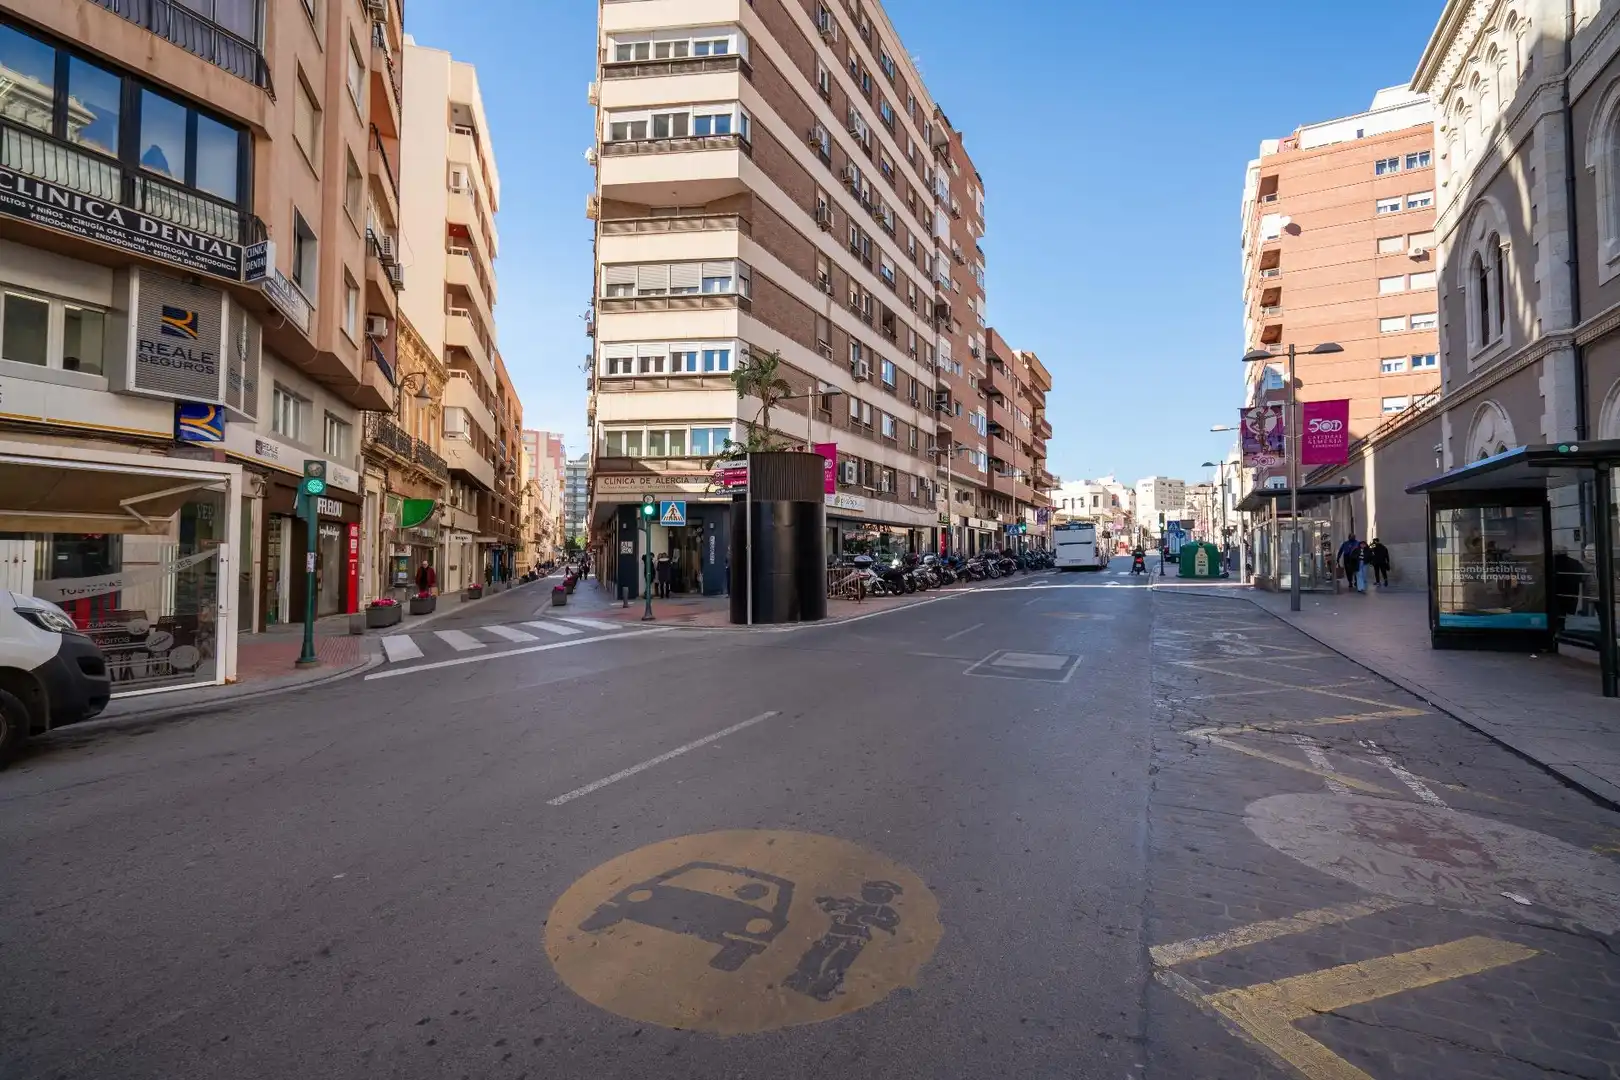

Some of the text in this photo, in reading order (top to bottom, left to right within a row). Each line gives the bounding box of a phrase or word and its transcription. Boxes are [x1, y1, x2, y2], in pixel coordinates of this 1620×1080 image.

[0, 171, 237, 261] CLINICA DENTAL
[0, 195, 26, 208] ULTOS
[37, 206, 64, 220] NIÑOS
[72, 217, 105, 232] CIRUGÍA
[106, 227, 127, 239] ORAL
[133, 236, 189, 258] IMPLANTOLOGÍA
[195, 255, 237, 272] ORTODONCIA
[31, 213, 208, 271] PERIODONCIA ENDODONCIA ESTÉTICA DENTAL
[139, 339, 215, 365] REALE
[138, 354, 215, 375] SEGUROS
[1308, 418, 1343, 432] 500
[639, 477, 651, 485] DE
[1476, 572, 1533, 581] renovables
